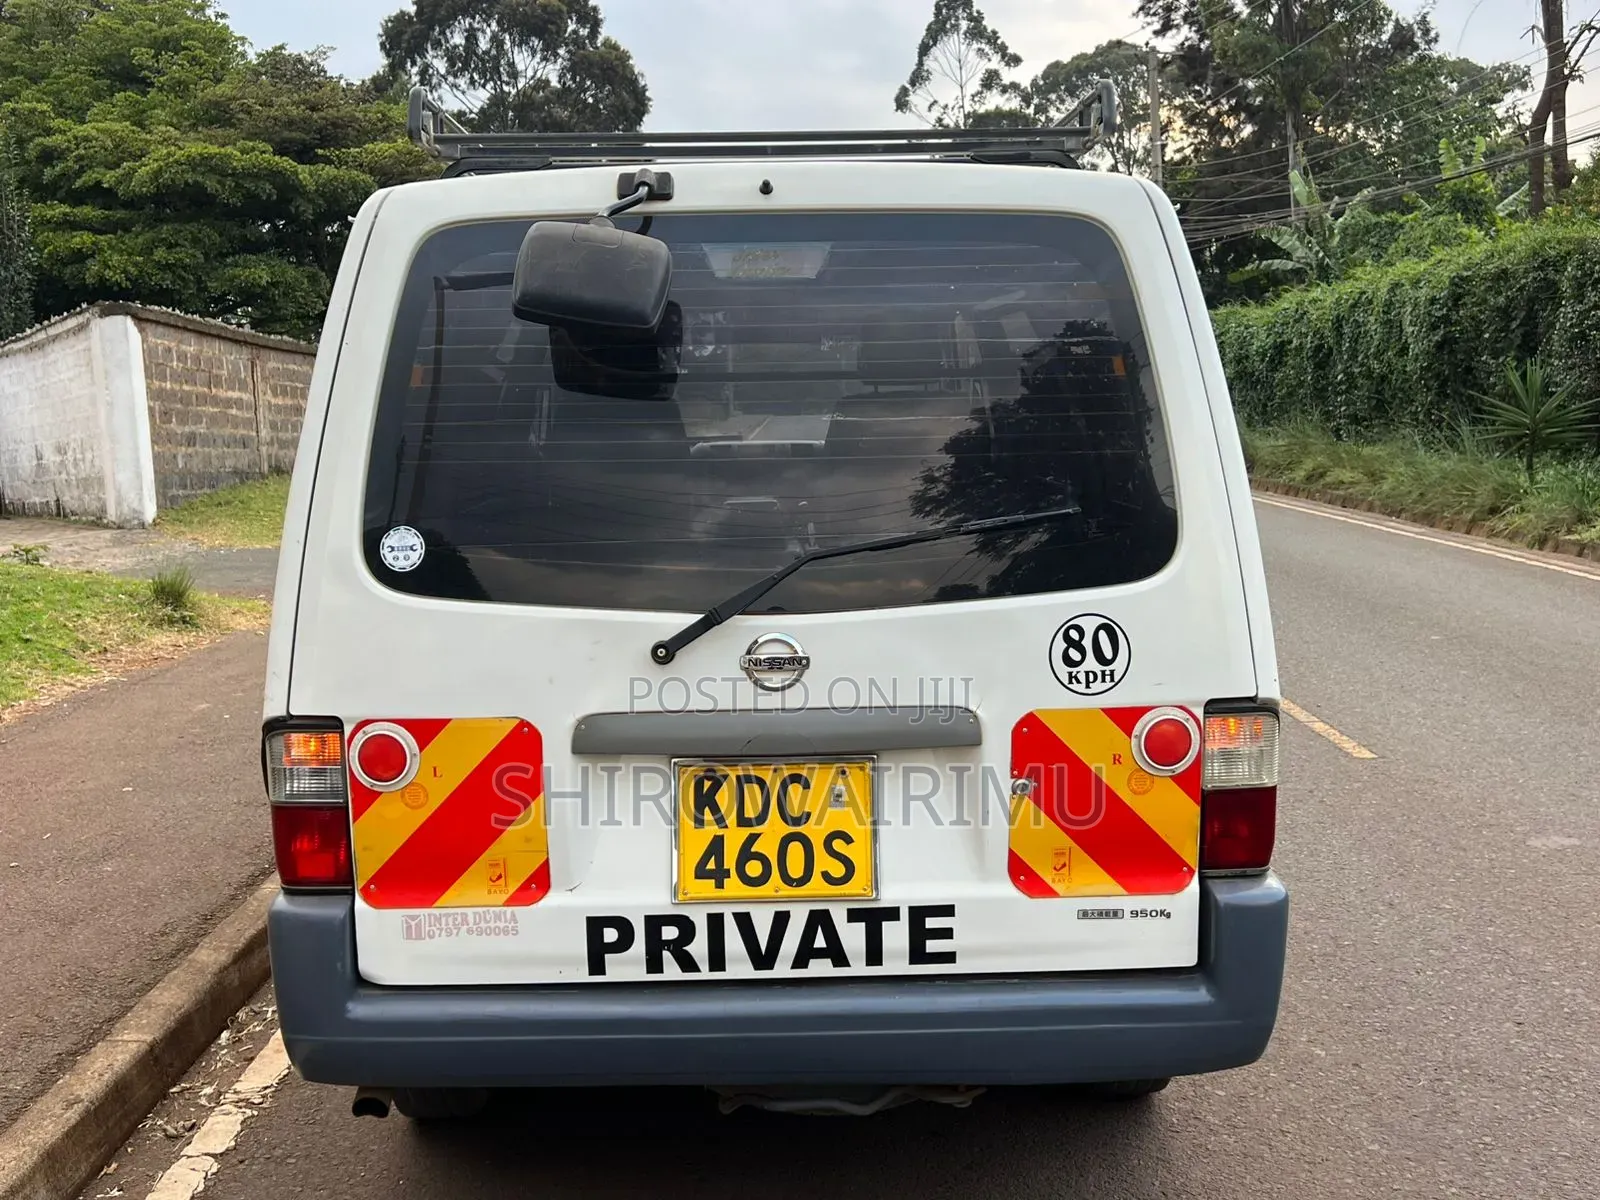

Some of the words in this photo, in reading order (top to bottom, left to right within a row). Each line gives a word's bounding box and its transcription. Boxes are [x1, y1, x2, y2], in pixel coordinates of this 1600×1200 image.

[1061, 622, 1120, 668] 80
[747, 655, 802, 667] NISSAN
[1112, 753, 1122, 765] R
[432, 765, 443, 778] L
[692, 772, 812, 830] KDC
[692, 831, 857, 890] 460S
[427, 912, 470, 928] INTER
[1129, 908, 1171, 919] 950Kg
[427, 926, 462, 940] 0797
[466, 924, 520, 937] 690065
[586, 904, 956, 976] PRIVATE
